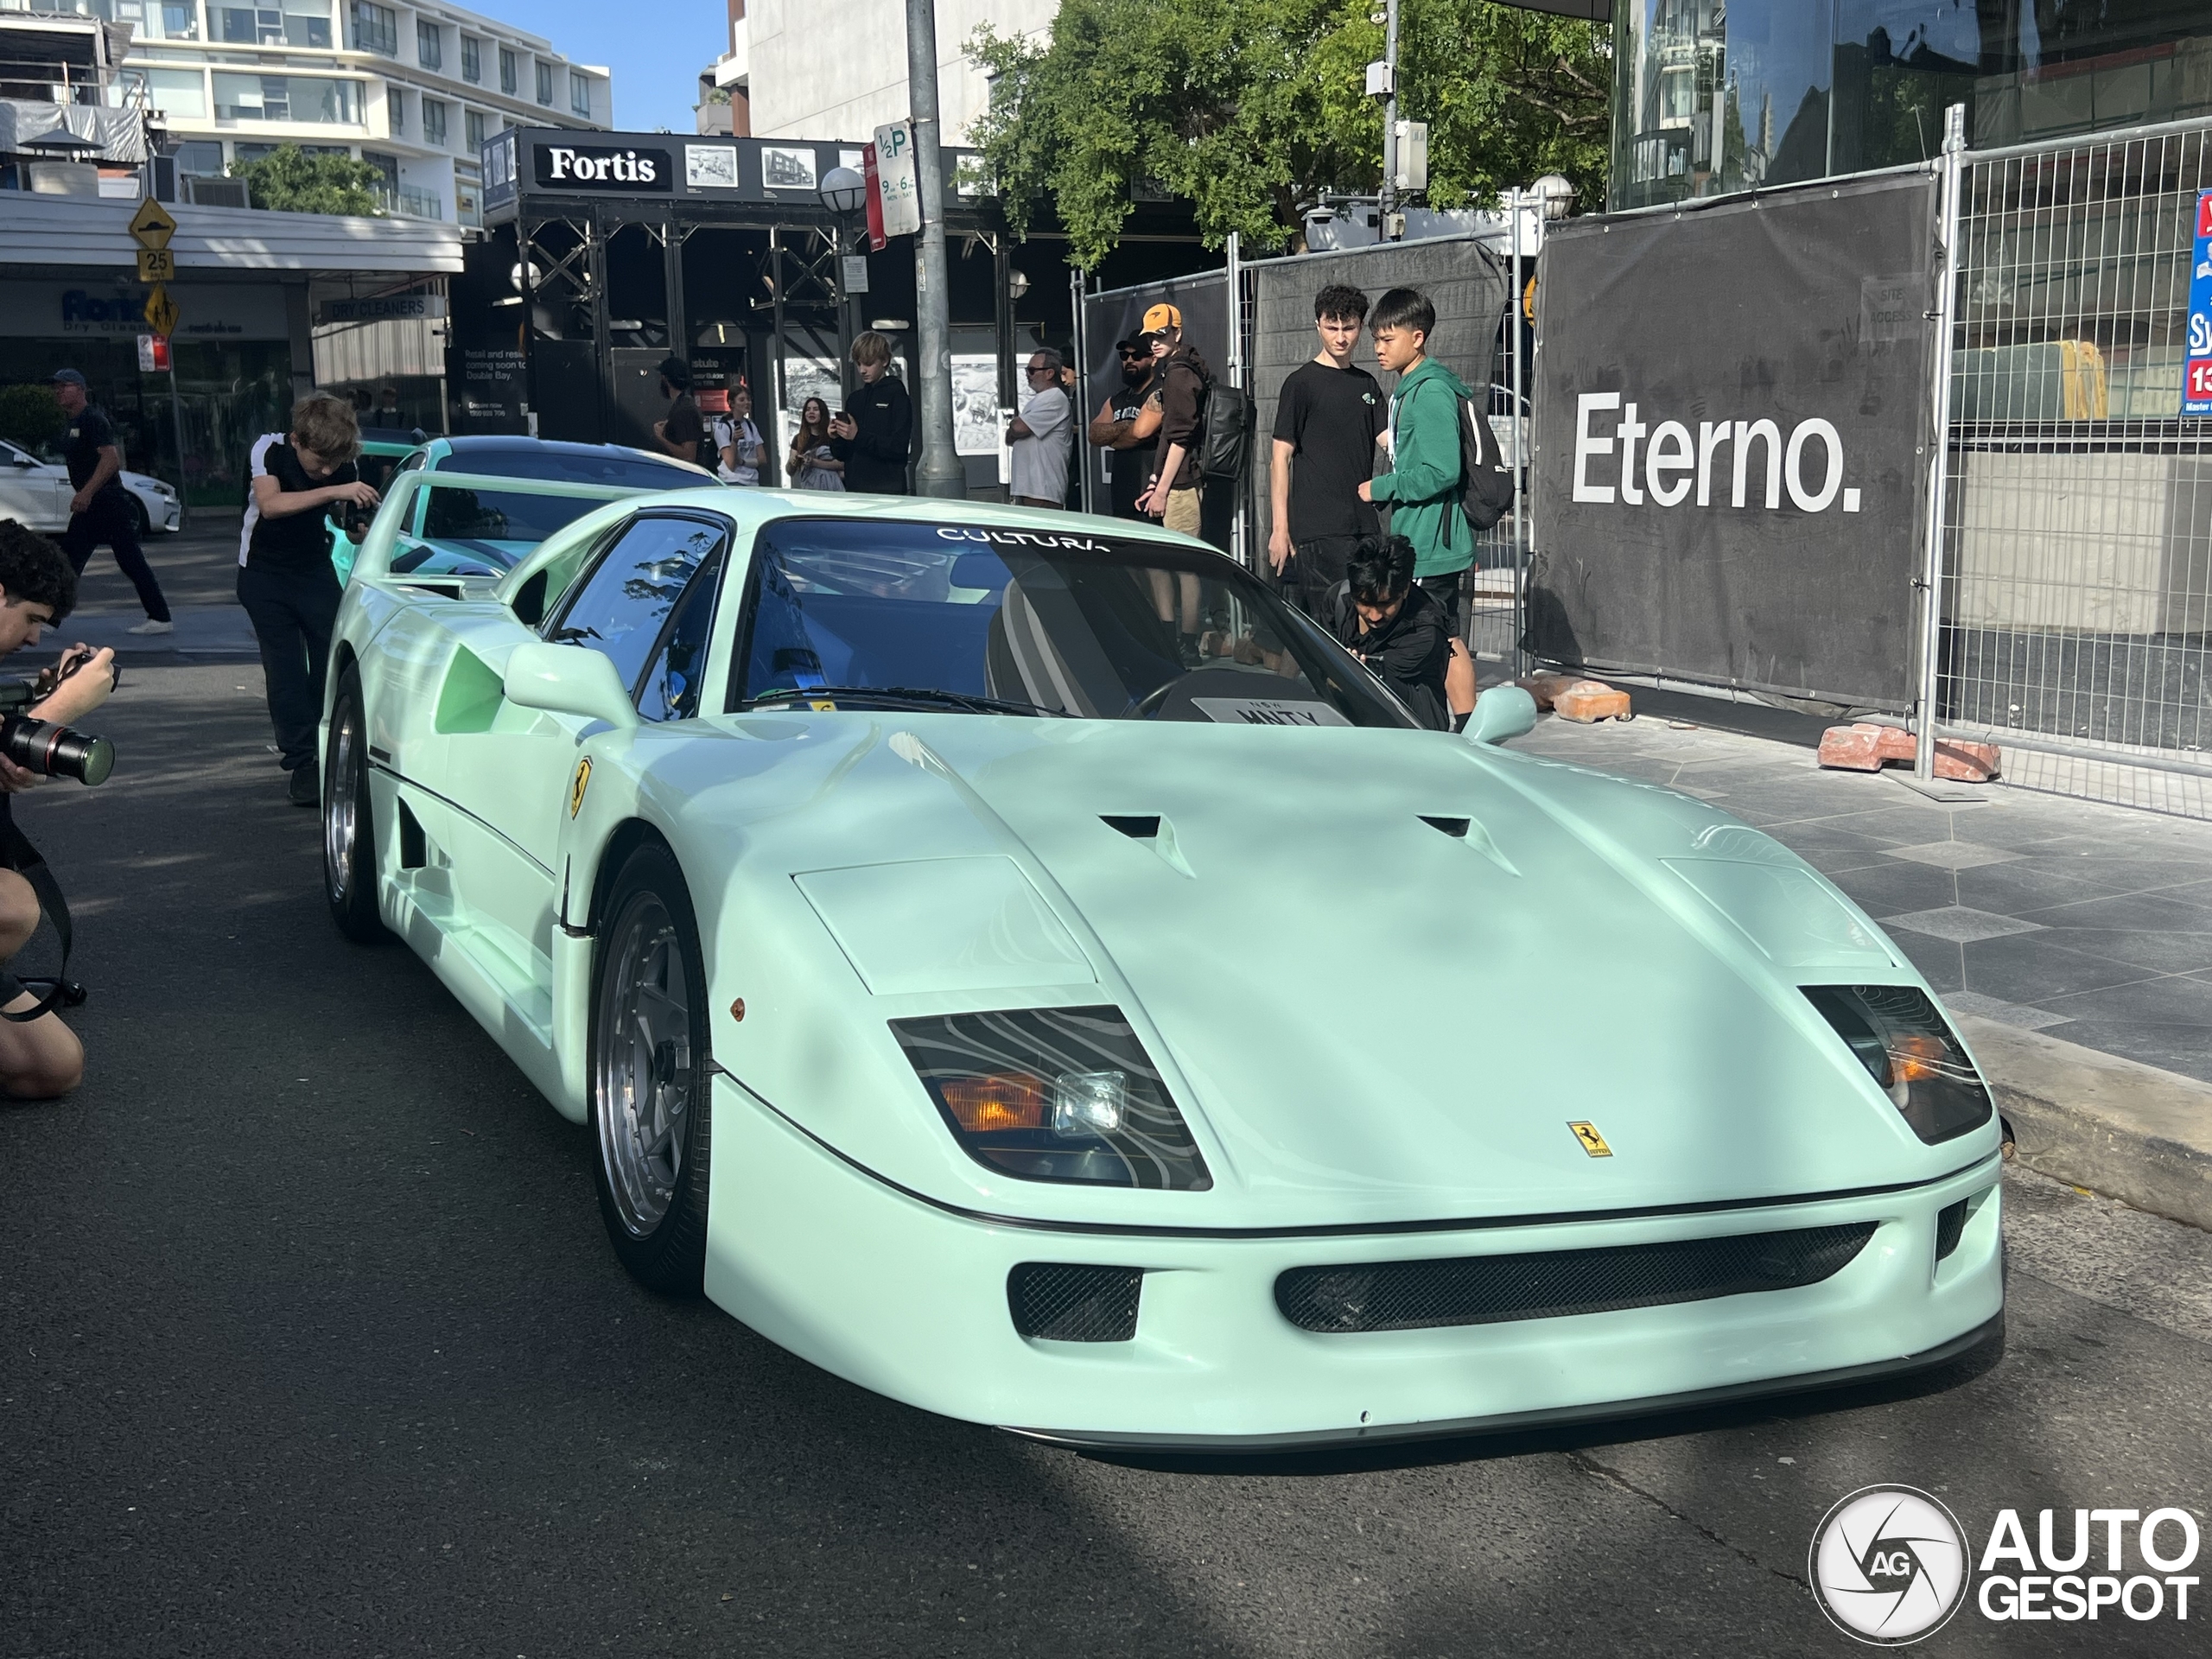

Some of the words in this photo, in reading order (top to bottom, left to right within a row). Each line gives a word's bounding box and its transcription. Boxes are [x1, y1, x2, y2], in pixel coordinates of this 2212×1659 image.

[548, 148, 656, 182] Fortis
[147, 252, 168, 270] 25
[1880, 288, 1903, 302] SITE
[332, 303, 356, 318] DRY
[359, 300, 424, 317] CLEANERS
[1870, 311, 1912, 324] ACCESS
[486, 349, 504, 359] and
[466, 361, 493, 371] coming
[467, 371, 493, 380] Double
[2185, 402, 2209, 411] Master
[1572, 391, 1861, 512] Eterno.
[936, 528, 1111, 553] CULTURA
[1249, 701, 1282, 709] NSW
